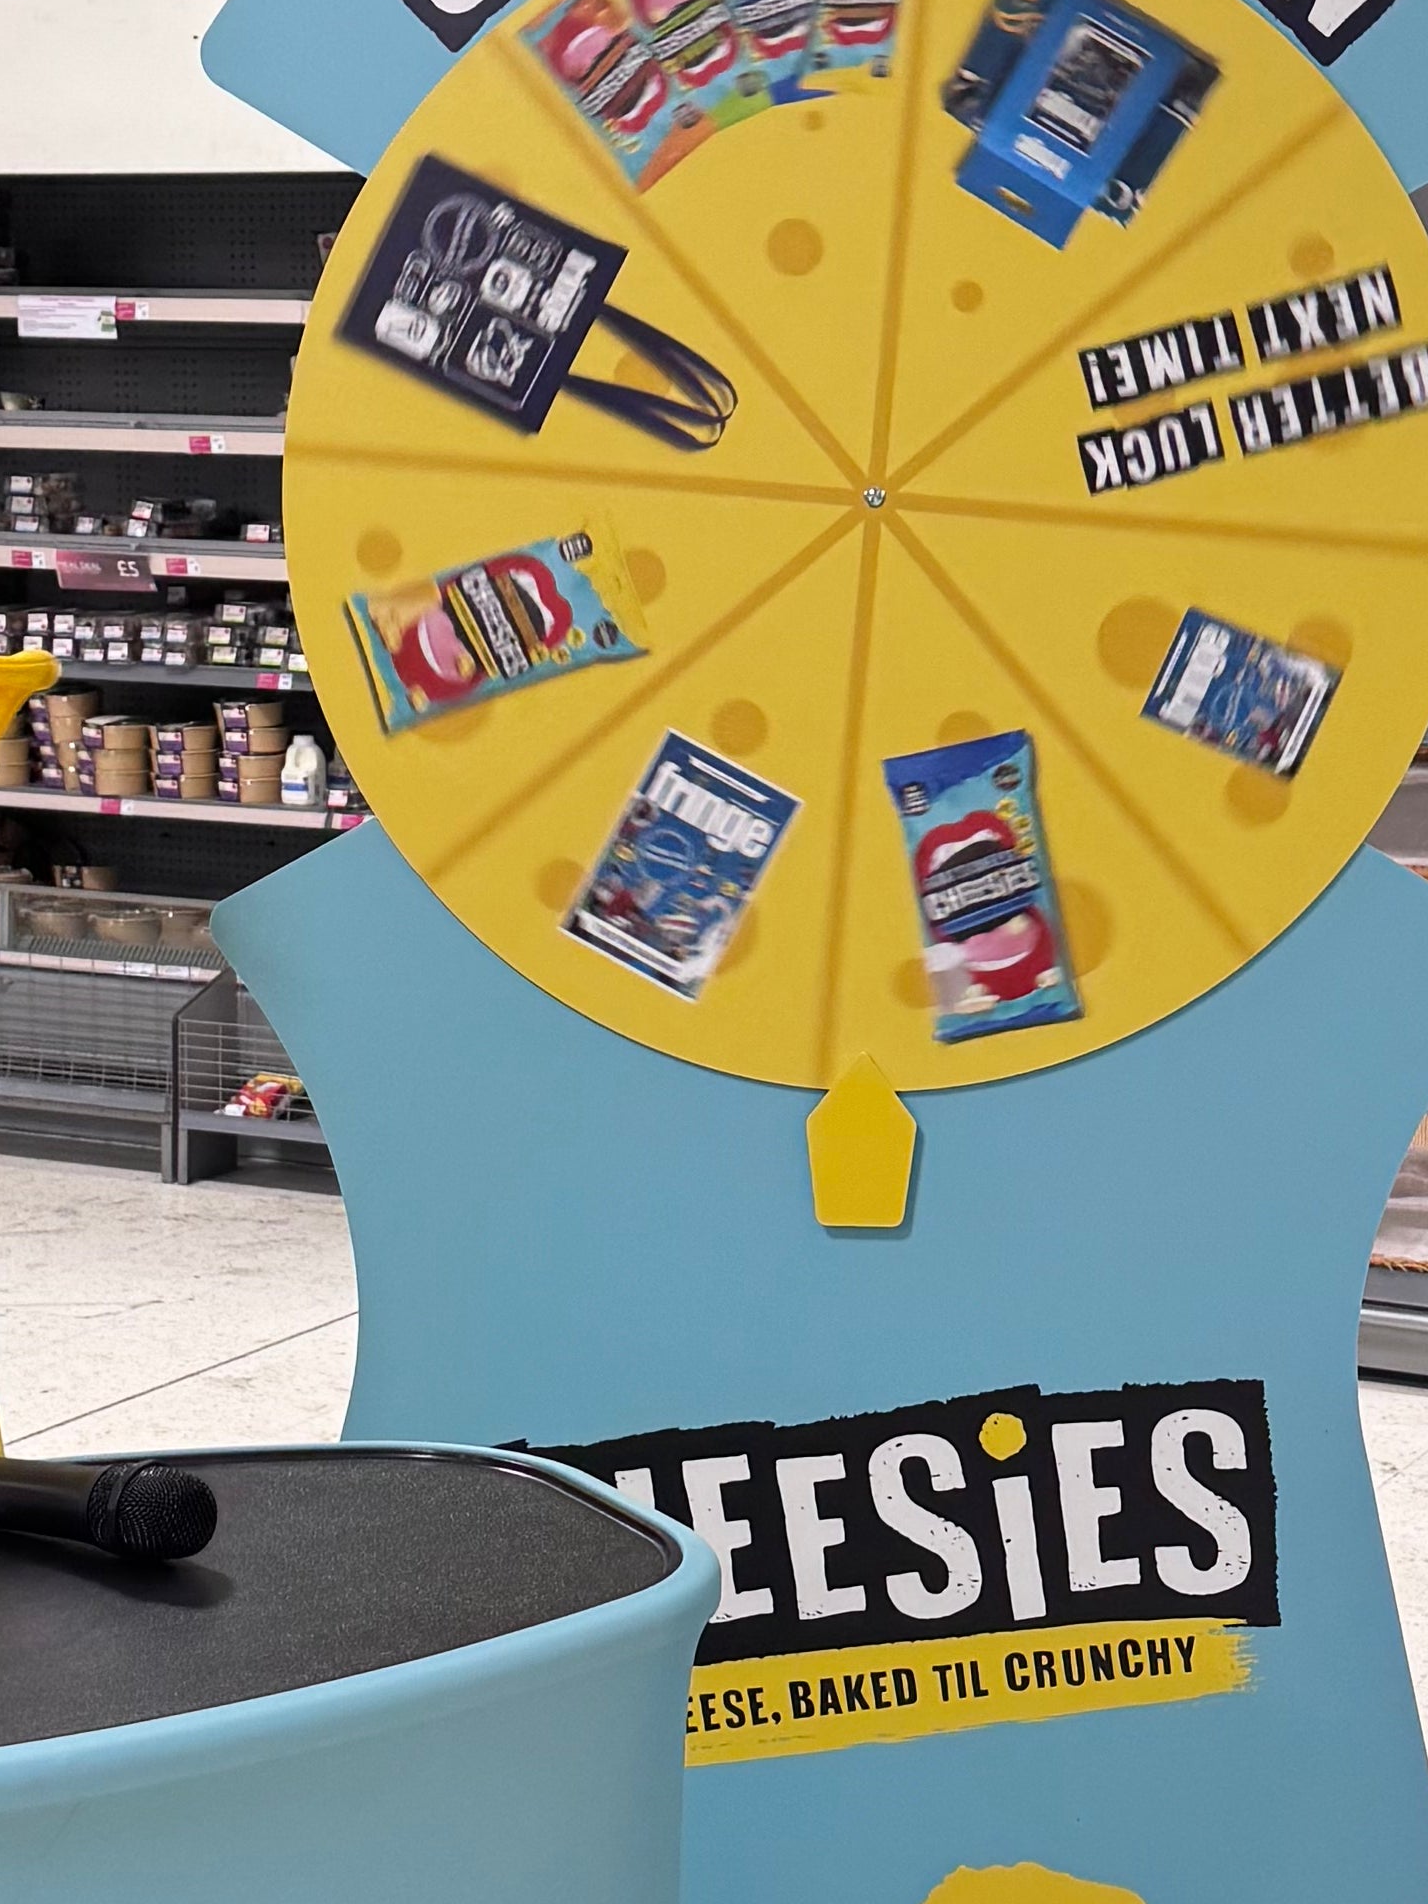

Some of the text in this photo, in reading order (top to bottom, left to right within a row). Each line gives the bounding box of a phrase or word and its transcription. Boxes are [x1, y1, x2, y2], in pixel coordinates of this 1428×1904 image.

[1087, 267, 1397, 403] NEXT TIME!
[1084, 404, 1219, 490] LUCK
[117, 560, 140, 577] £5
[790, 1668, 918, 1720] BAKED
[932, 1660, 990, 1702] TIL
[1004, 1636, 1198, 1692] CRUNCHY
